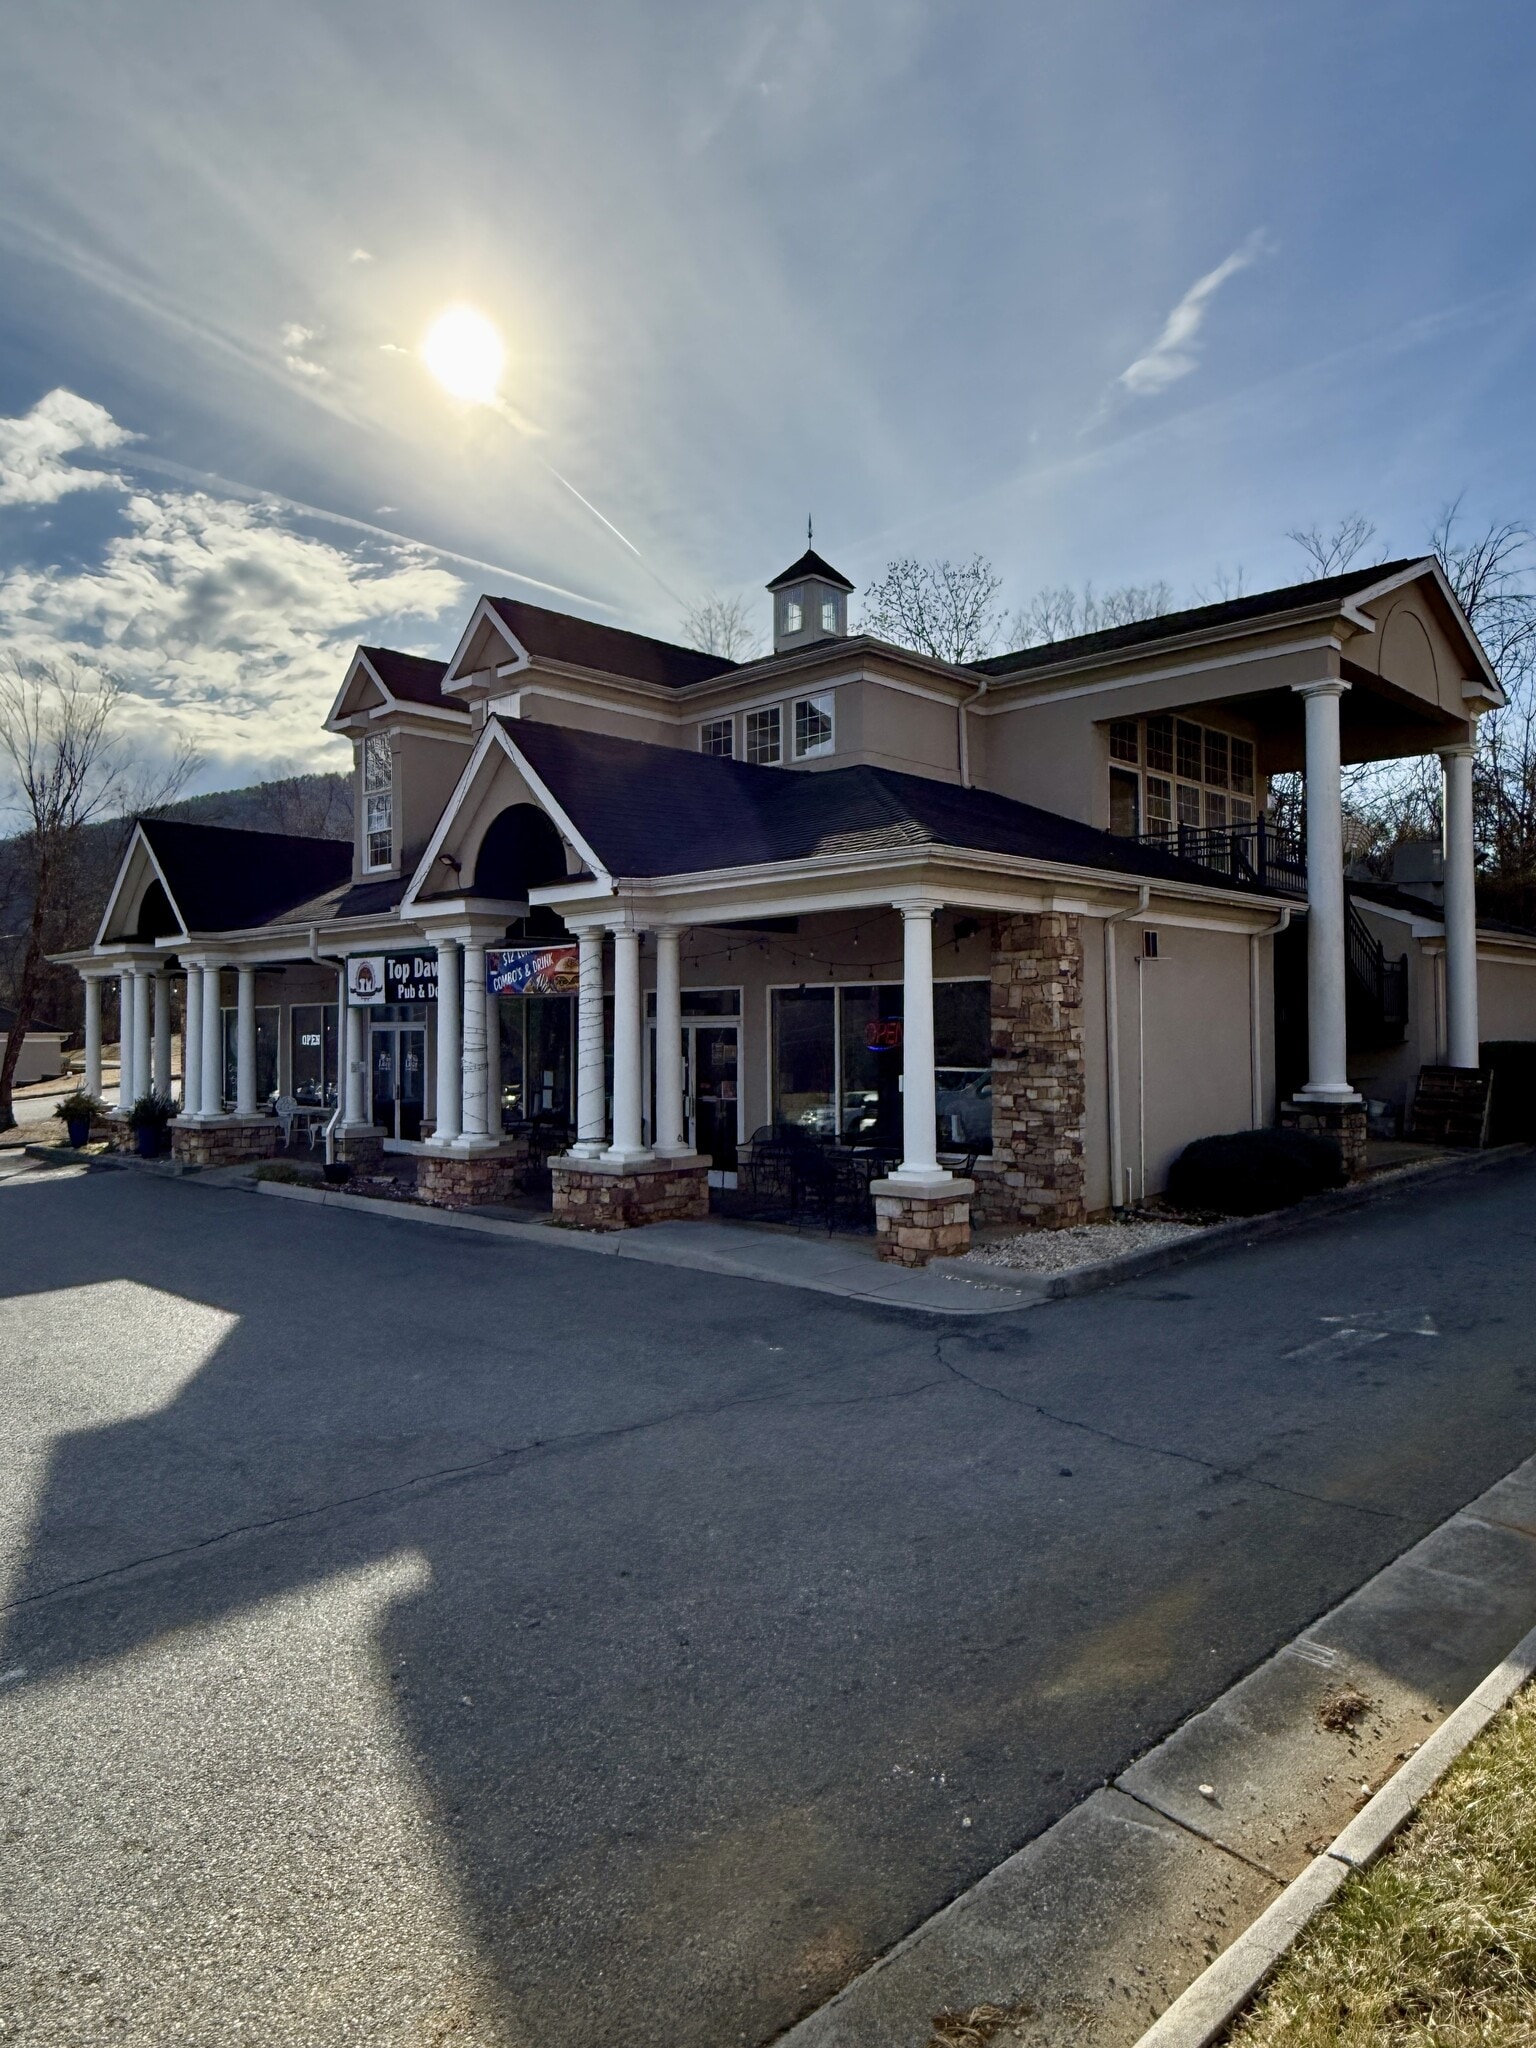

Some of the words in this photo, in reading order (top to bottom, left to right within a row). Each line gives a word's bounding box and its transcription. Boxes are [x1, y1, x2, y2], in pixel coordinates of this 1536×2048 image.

[387, 959, 410, 984] Top
[493, 967, 523, 991] COMBO'S
[525, 963, 531, 977] &
[397, 983, 416, 999] Pub
[418, 983, 425, 998] &
[302, 1034, 321, 1046] OPEN
